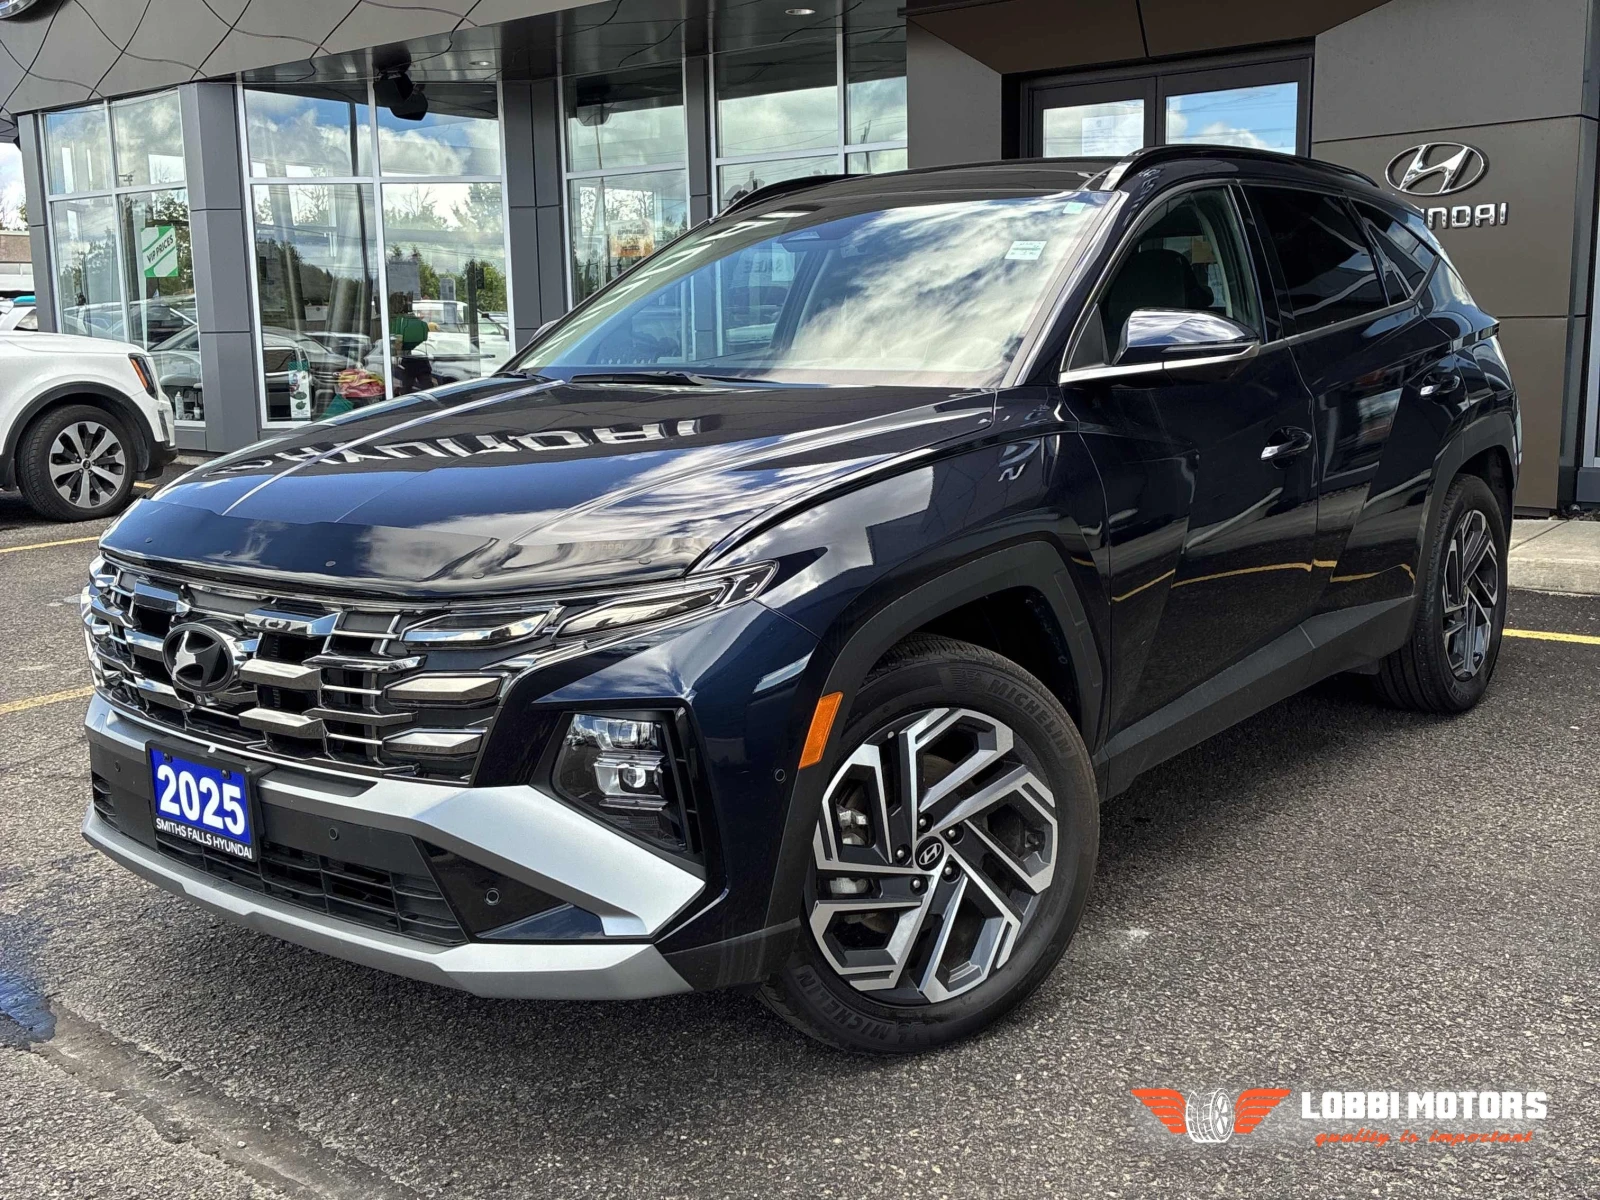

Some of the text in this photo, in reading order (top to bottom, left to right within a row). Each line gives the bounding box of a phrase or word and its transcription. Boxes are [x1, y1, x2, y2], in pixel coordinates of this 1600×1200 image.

[1420, 202, 1507, 230] NDAI
[156, 234, 174, 256] PRICES
[989, 679, 1072, 752] MICHELIN
[157, 764, 245, 835] 2025
[156, 818, 253, 859] SMITHS FALLS HYUNDAI
[796, 969, 891, 1041] MICHELIN
